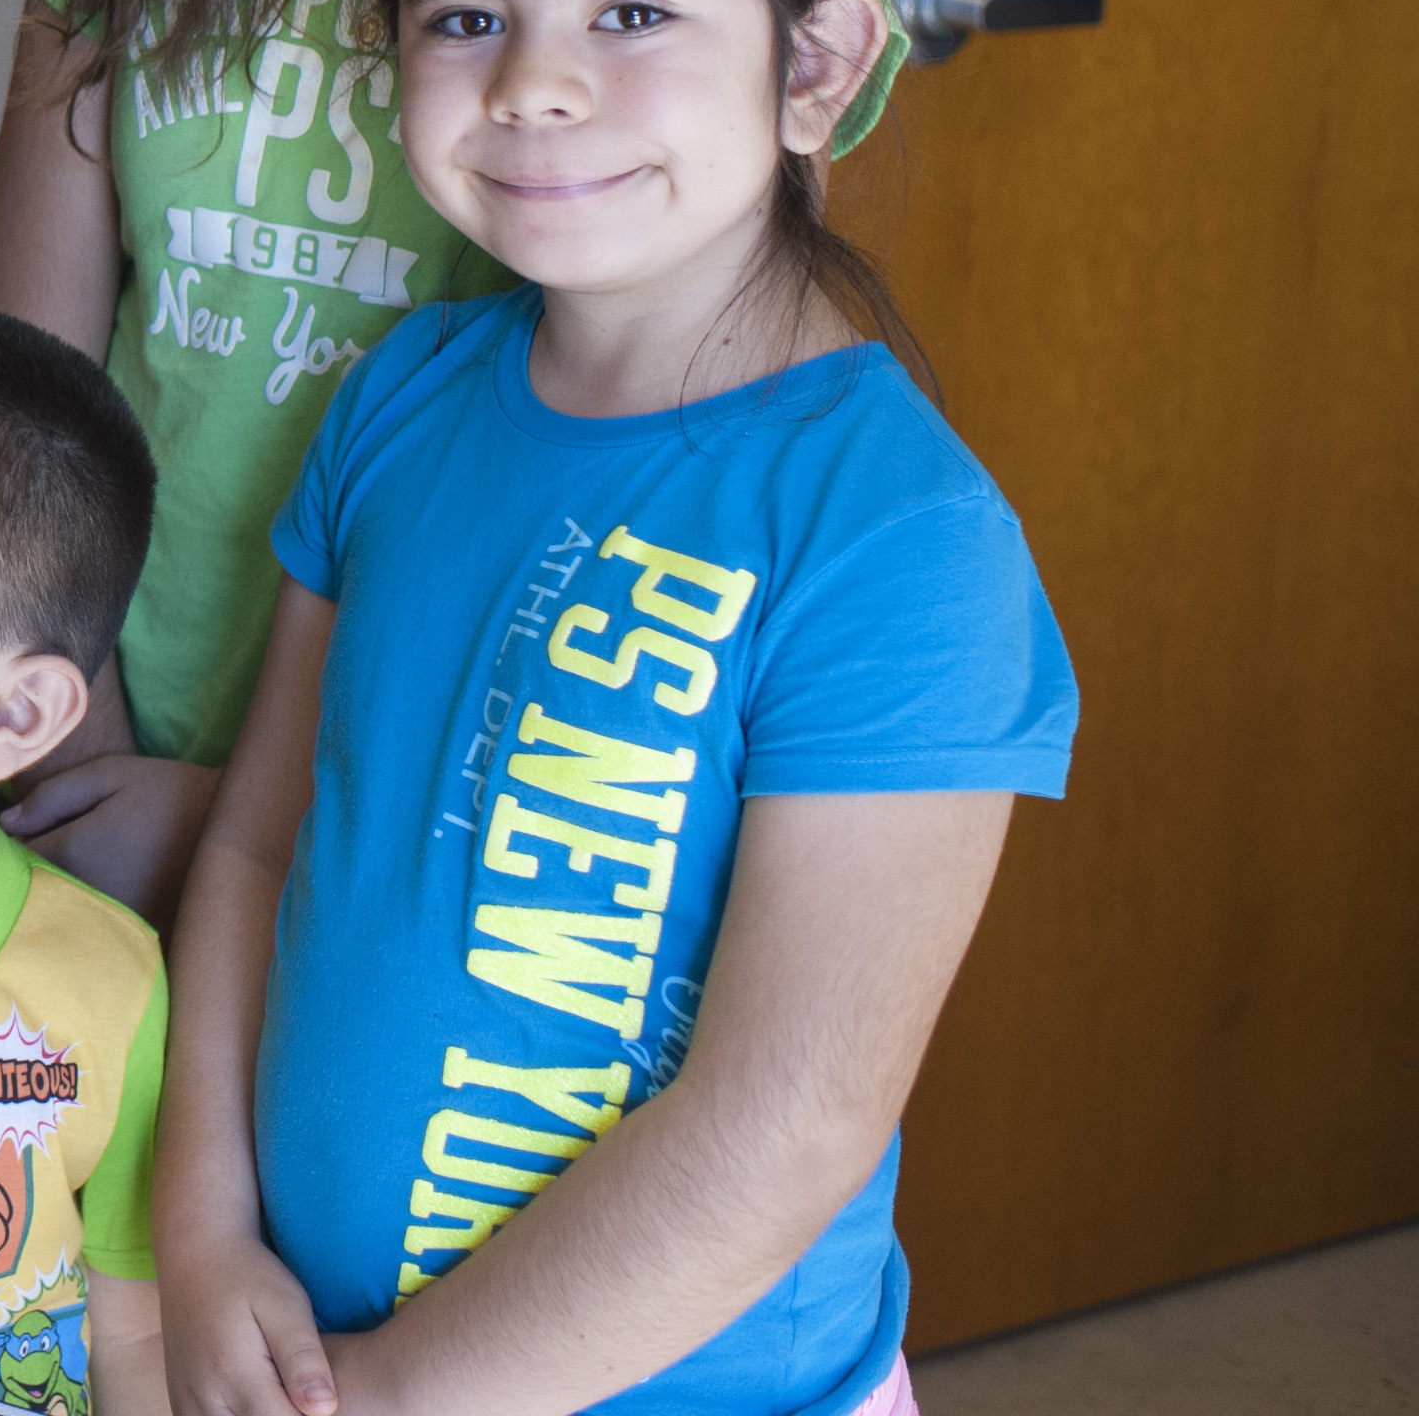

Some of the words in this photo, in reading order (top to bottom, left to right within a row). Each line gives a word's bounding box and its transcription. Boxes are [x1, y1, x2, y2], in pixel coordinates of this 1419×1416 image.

[235, 38, 395, 225] PS
[149, 266, 247, 357] New
[265, 286, 366, 406] Yor
[495, 516, 594, 667] ATHL.
[547, 524, 757, 717] PS
[466, 702, 696, 1041] NEW
[393, 1045, 631, 1312] YOR
